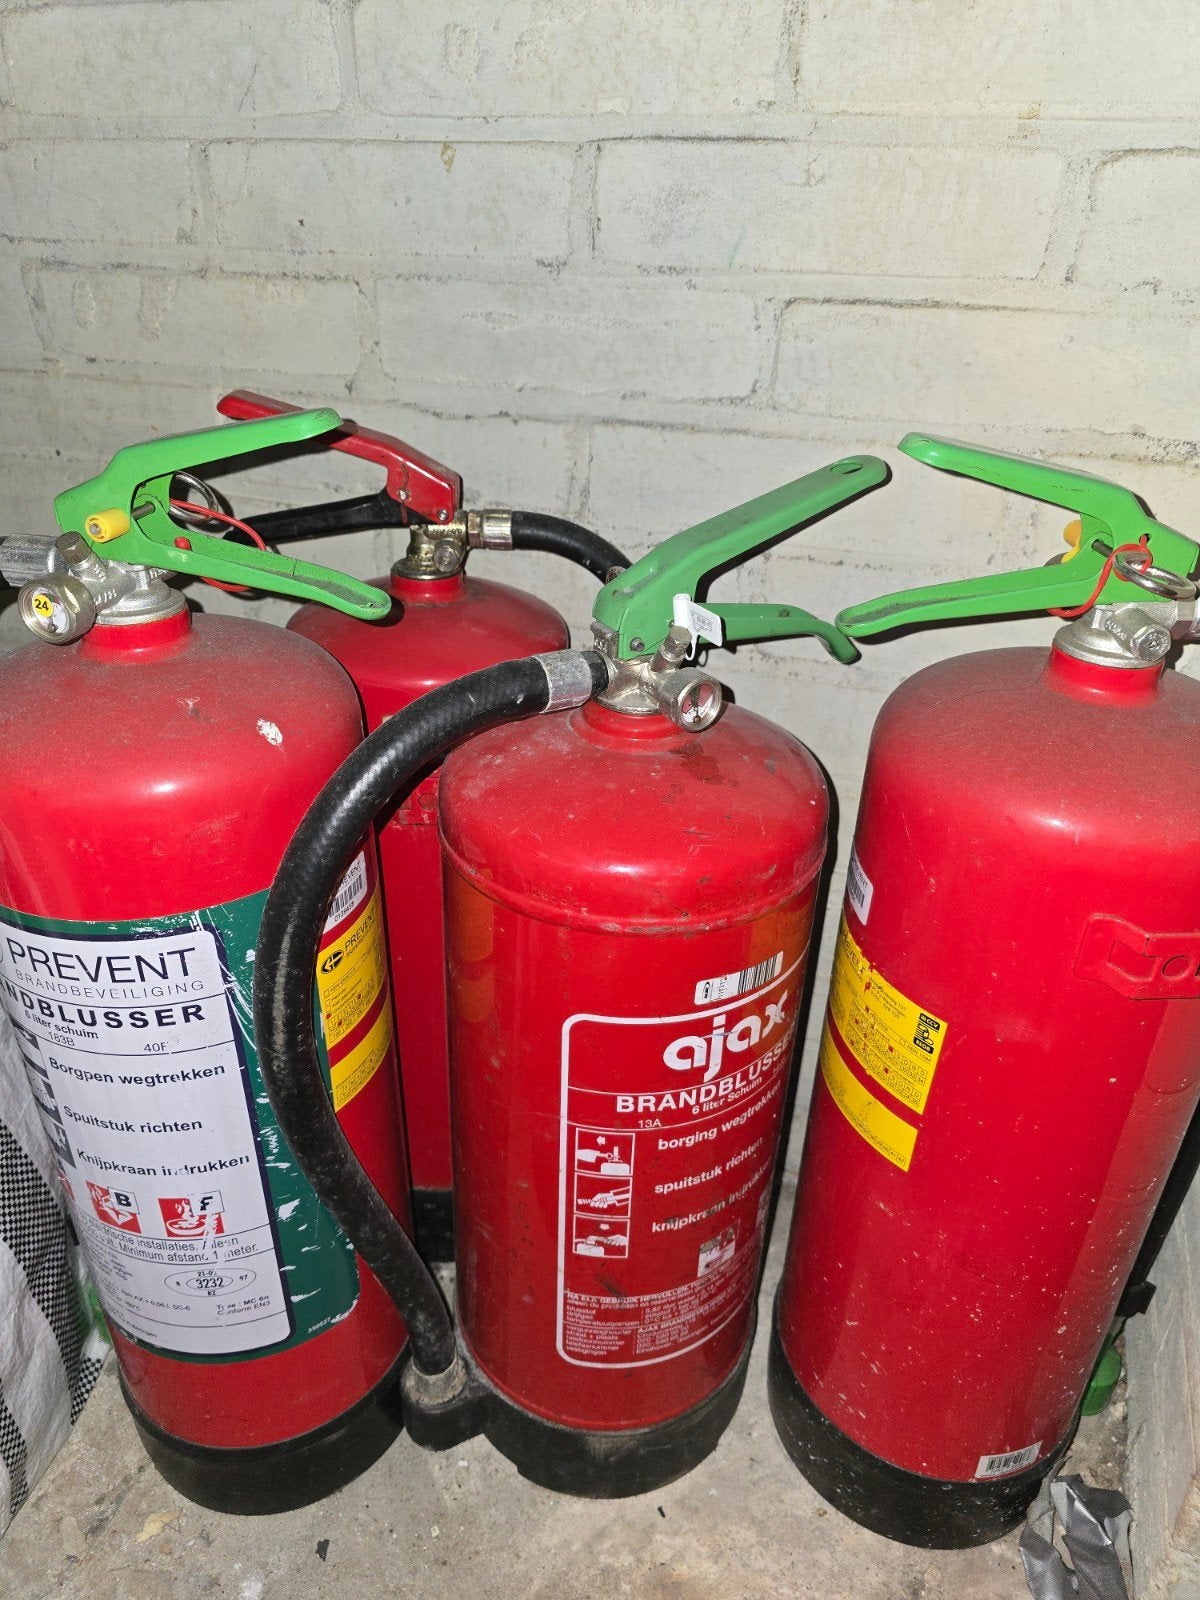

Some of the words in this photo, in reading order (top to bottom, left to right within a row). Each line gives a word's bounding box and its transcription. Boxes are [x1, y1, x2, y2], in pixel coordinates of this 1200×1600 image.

[34, 598, 49, 611] 24
[6, 937, 196, 983] PREVENT
[15, 969, 204, 1000] BRANDBEVEILIGING
[32, 1013, 52, 1028] liter
[54, 1023, 99, 1040] schuim
[663, 989, 788, 1083] ajax
[48, 1031, 75, 1047] 183B
[143, 1041, 168, 1053] 40F
[48, 1057, 114, 1083] Borgpen
[119, 1064, 226, 1087] wegtrekken
[692, 1105, 699, 1114] 6
[702, 1095, 726, 1113] liter
[727, 1076, 762, 1103] Schuim
[64, 1106, 136, 1133] Spuitstuk
[140, 1119, 203, 1134] richten
[638, 1119, 662, 1129] 13A
[657, 1127, 718, 1150] borging
[721, 1080, 781, 1132] wegtrekken
[77, 1149, 157, 1176] Knijpkraan
[654, 1165, 722, 1194] spuitstuk
[726, 1137, 763, 1170] richten
[114, 1192, 132, 1207] B
[200, 1195, 213, 1211] F
[652, 1200, 726, 1233] knijpkraan
[118, 1242, 164, 1261] Minimum
[213, 1249, 219, 1259] 1
[137, 1237, 199, 1251] installaties.
[195, 1276, 223, 1290] 3232
